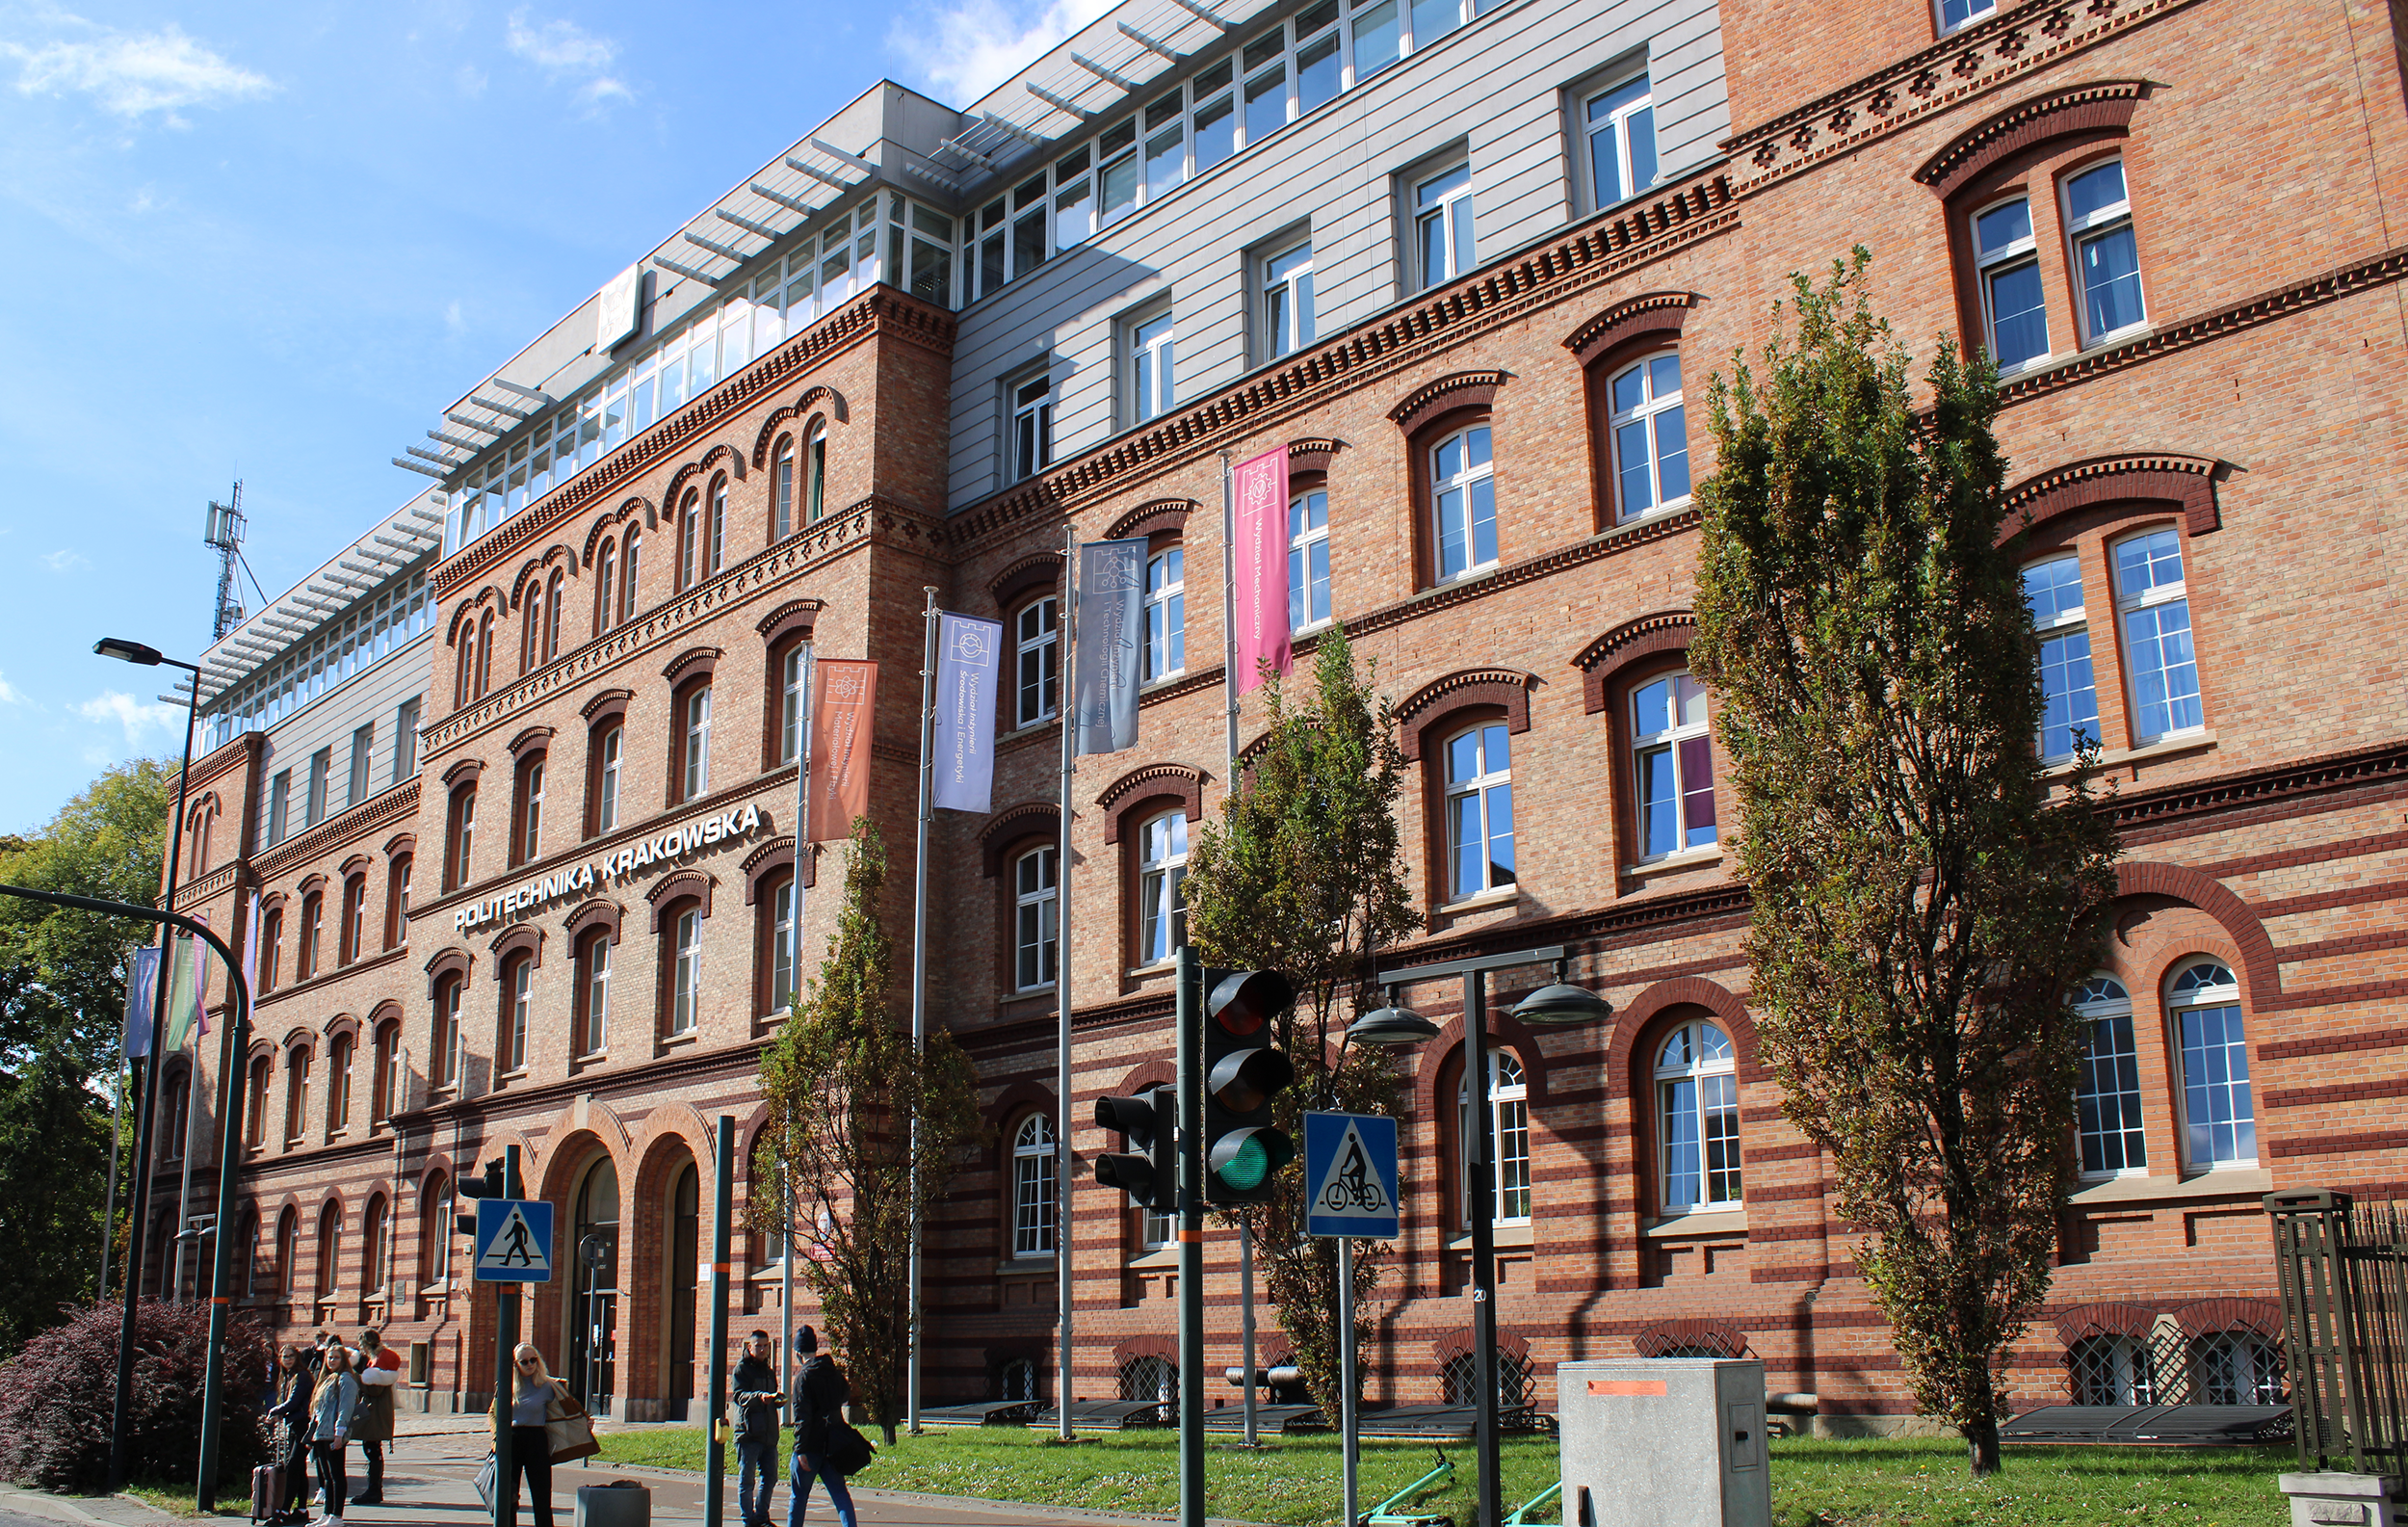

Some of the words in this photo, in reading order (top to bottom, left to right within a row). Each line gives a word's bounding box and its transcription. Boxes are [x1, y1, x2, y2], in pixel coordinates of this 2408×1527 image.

[1253, 517, 1263, 565] Wydział
[1113, 599, 1125, 642] Wydział
[1253, 566, 1263, 640] Mechaniczny
[1099, 605, 1112, 667] Technologii
[957, 670, 968, 724] Środowiska
[968, 672, 980, 712] Wydział
[1095, 667, 1109, 728] Chemicznej
[828, 710, 843, 769] Materiałowej
[844, 711, 855, 748] Wydział
[967, 712, 977, 754] Inżynierii
[955, 731, 965, 783] Energetyki
[454, 863, 595, 932] POLITECHNIKA
[601, 803, 761, 881] KRAKOWSKA
[1474, 1288, 1487, 1302] 20
